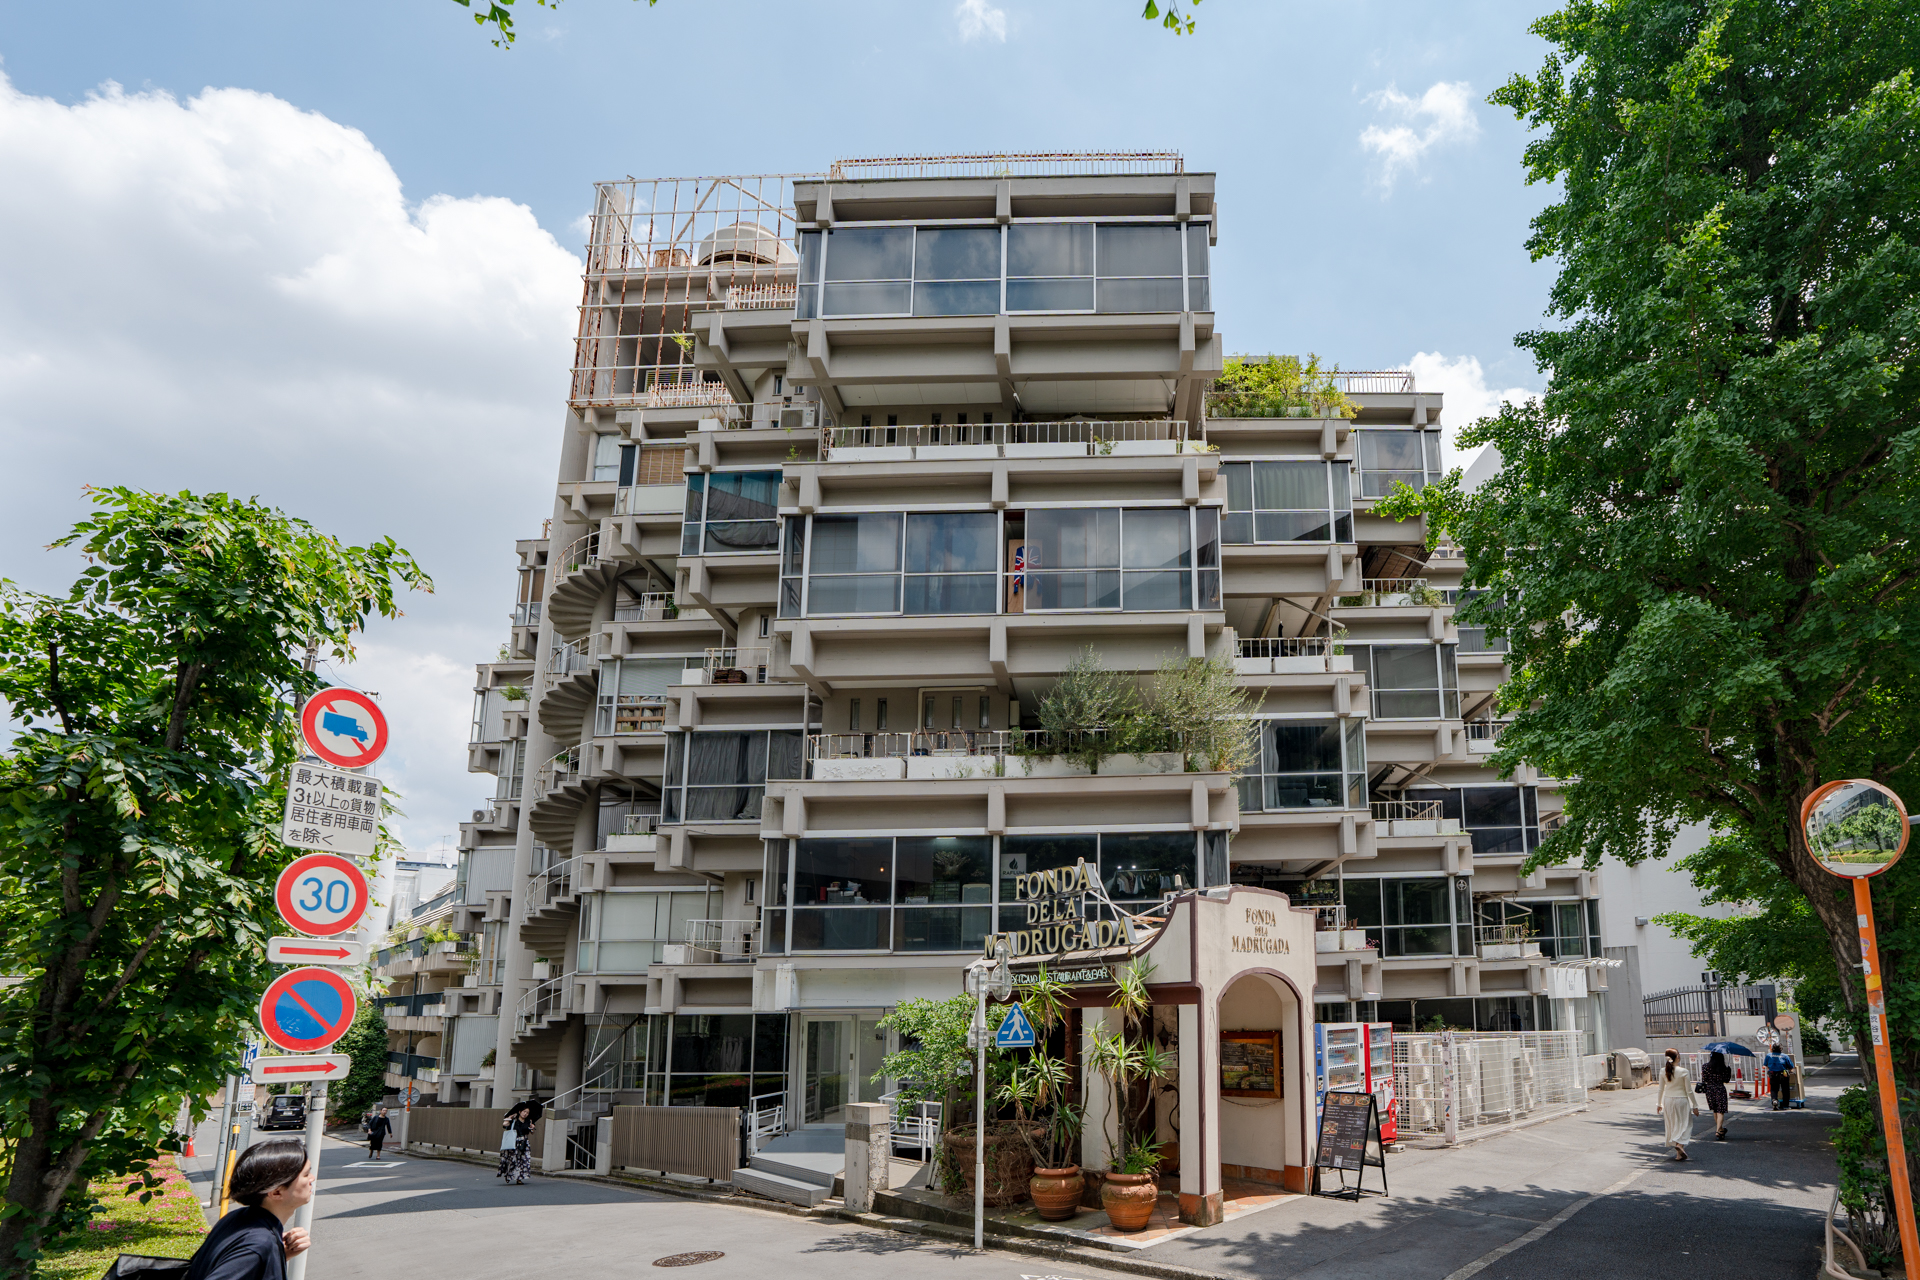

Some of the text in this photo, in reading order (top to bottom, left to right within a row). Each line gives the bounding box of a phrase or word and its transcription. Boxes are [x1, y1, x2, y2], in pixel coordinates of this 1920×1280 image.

[296, 768, 378, 798] 最大積載量
[293, 787, 376, 816] 3t以上の貨物
[290, 806, 374, 834] 居住者用車両
[288, 827, 334, 846] を除く
[299, 876, 350, 914] 30
[1015, 862, 1094, 900] FONDA
[1245, 908, 1277, 927] FONDA
[1231, 935, 1290, 955] MADRUGADA
